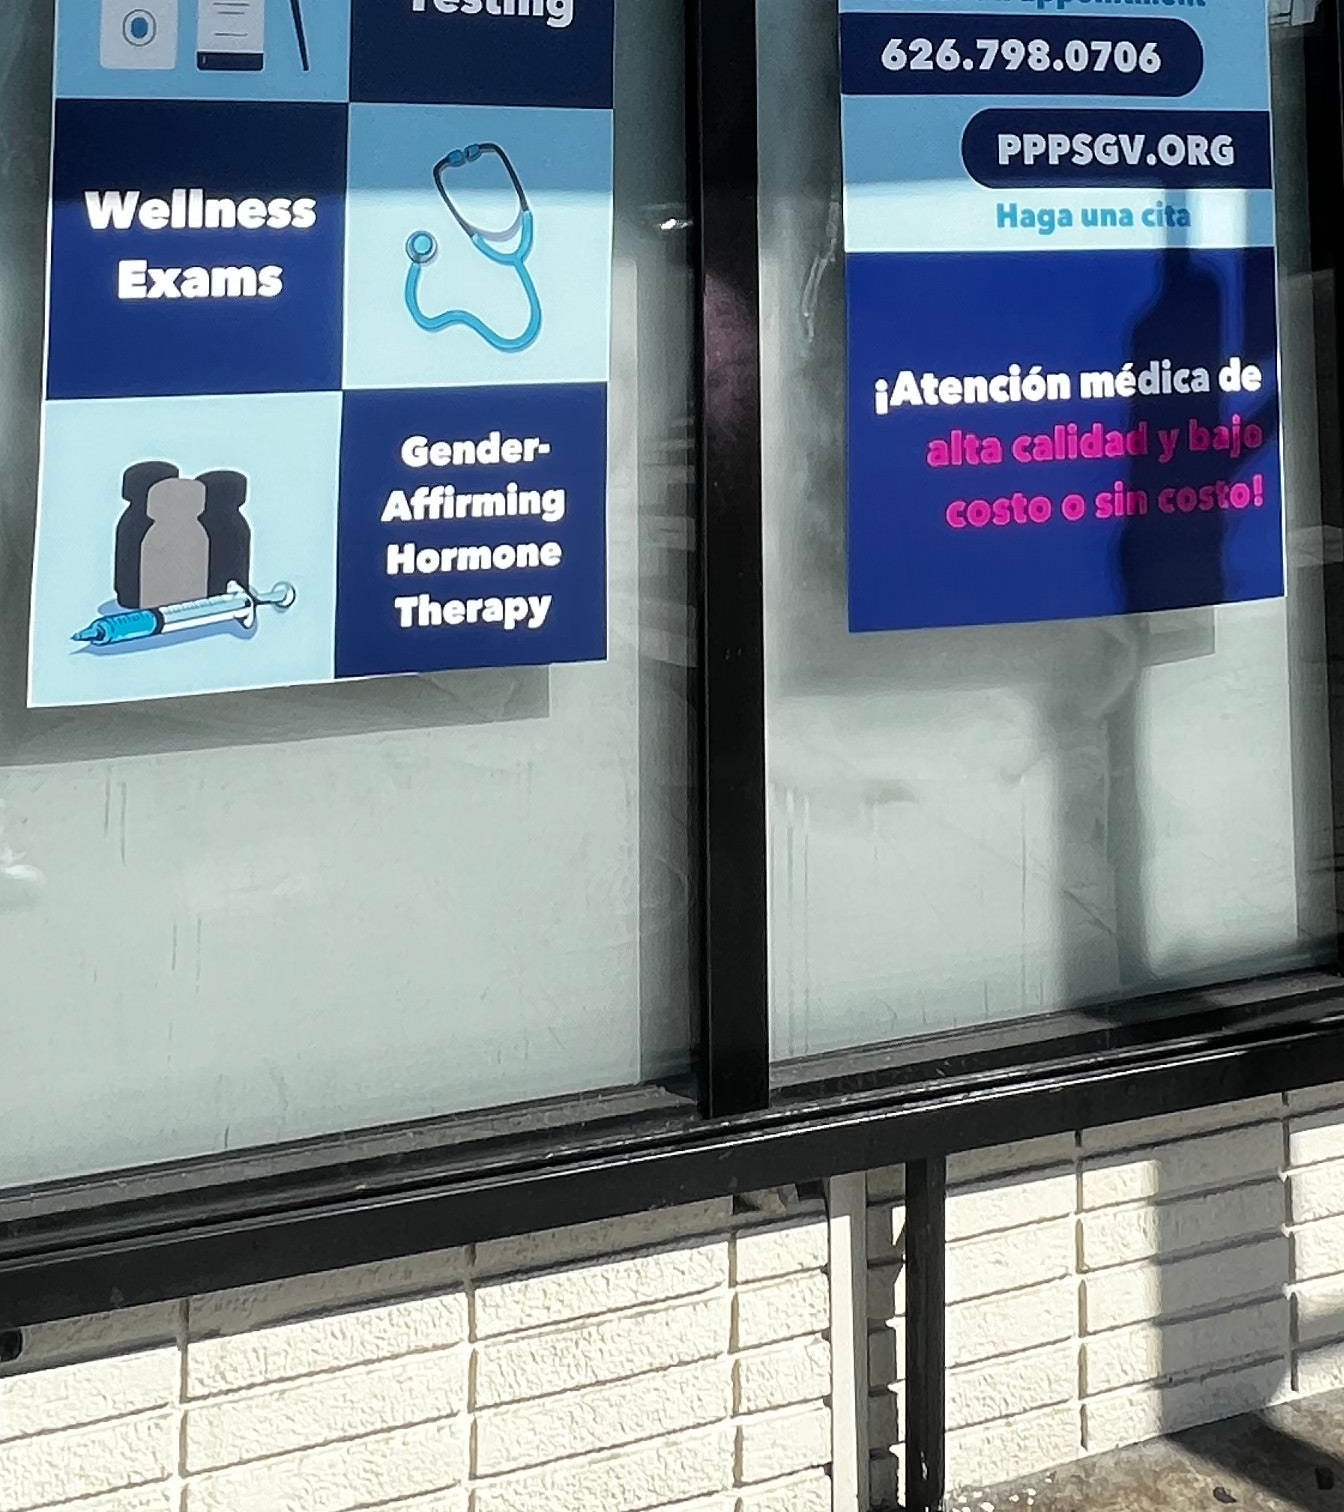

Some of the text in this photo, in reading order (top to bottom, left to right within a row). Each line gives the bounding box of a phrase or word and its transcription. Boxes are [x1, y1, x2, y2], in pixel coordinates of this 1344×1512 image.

[881, 38, 1161, 73] 626.798.0706
[998, 133, 1234, 166] PPPSGV.ORG
[84, 189, 317, 231] Wellness
[996, 201, 1191, 235] Haga una cita
[117, 259, 283, 300] Exams
[875, 357, 1262, 415] ¡Atención médica de
[400, 431, 550, 468] Gender-
[926, 414, 1263, 467] alta calidad y bajo
[381, 483, 566, 524] Affirming
[945, 474, 1264, 528] costo o sin costo!
[386, 541, 563, 575] Hormone
[394, 592, 553, 630] Therapy
